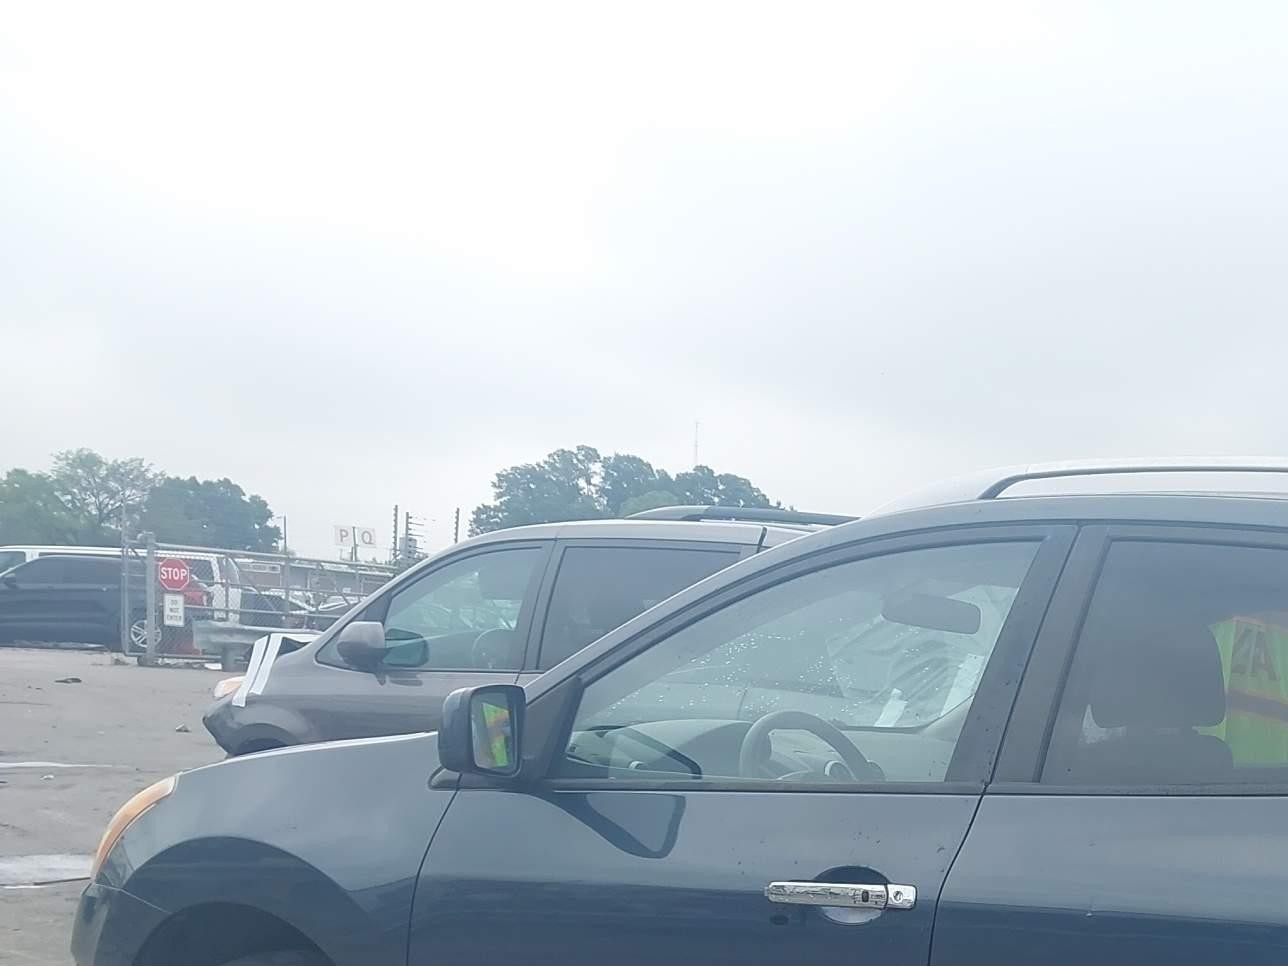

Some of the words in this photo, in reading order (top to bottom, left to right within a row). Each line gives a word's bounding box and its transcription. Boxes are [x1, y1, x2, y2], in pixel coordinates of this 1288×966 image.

[340, 529, 349, 543] P
[361, 530, 374, 545] Q
[160, 567, 187, 580] STOP
